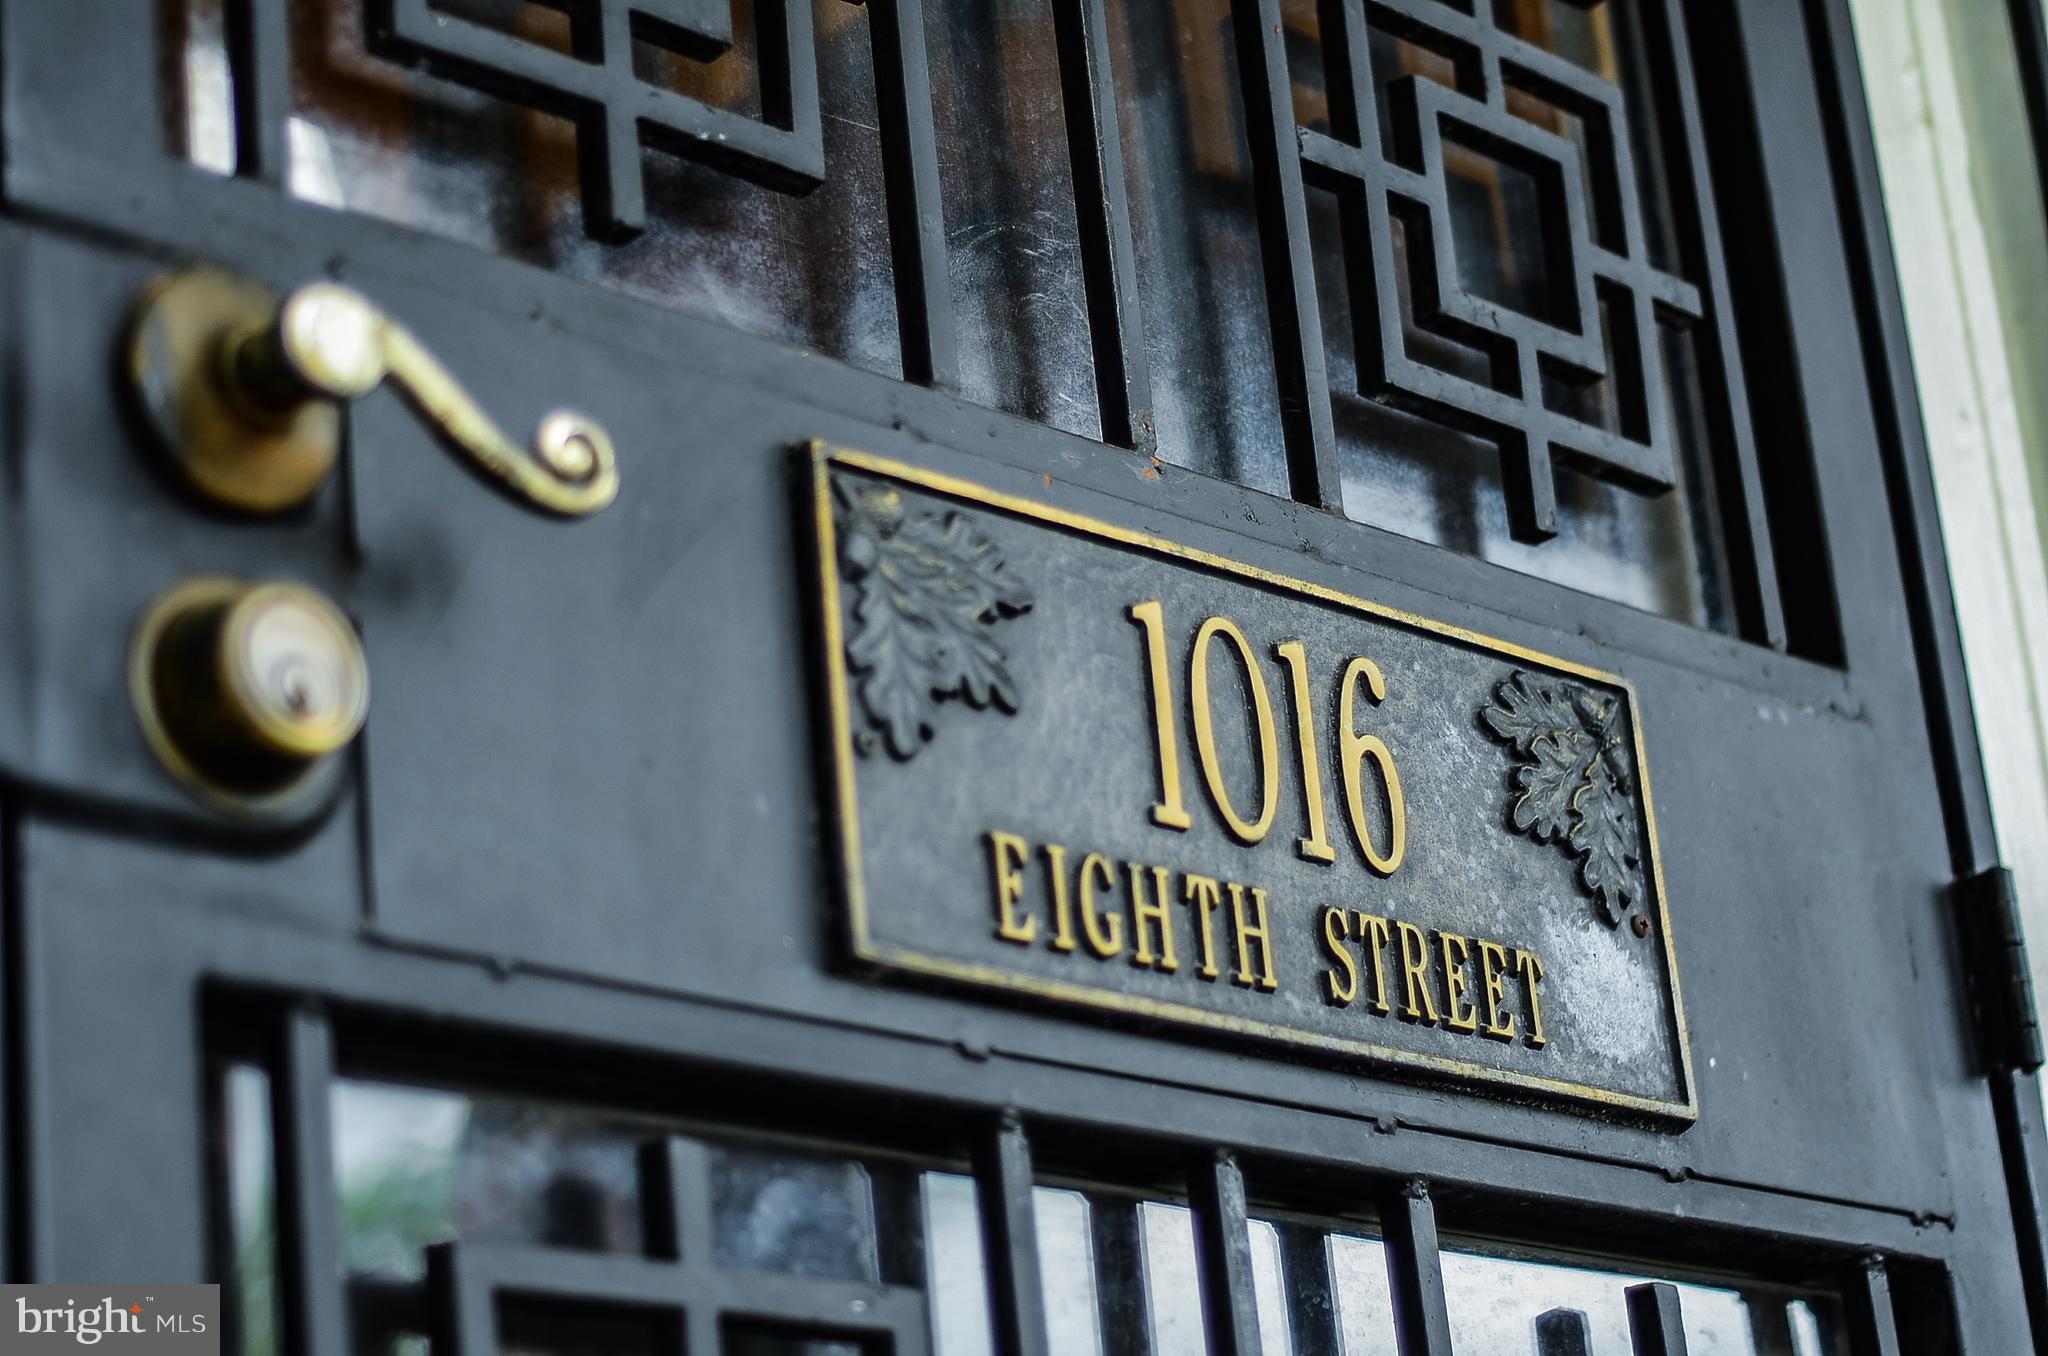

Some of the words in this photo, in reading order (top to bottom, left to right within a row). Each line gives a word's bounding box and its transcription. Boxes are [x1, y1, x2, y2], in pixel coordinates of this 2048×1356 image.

[1131, 599, 1406, 877] 1016
[988, 830, 1279, 992] EIGHTH
[1323, 904, 1547, 1047] STREET
